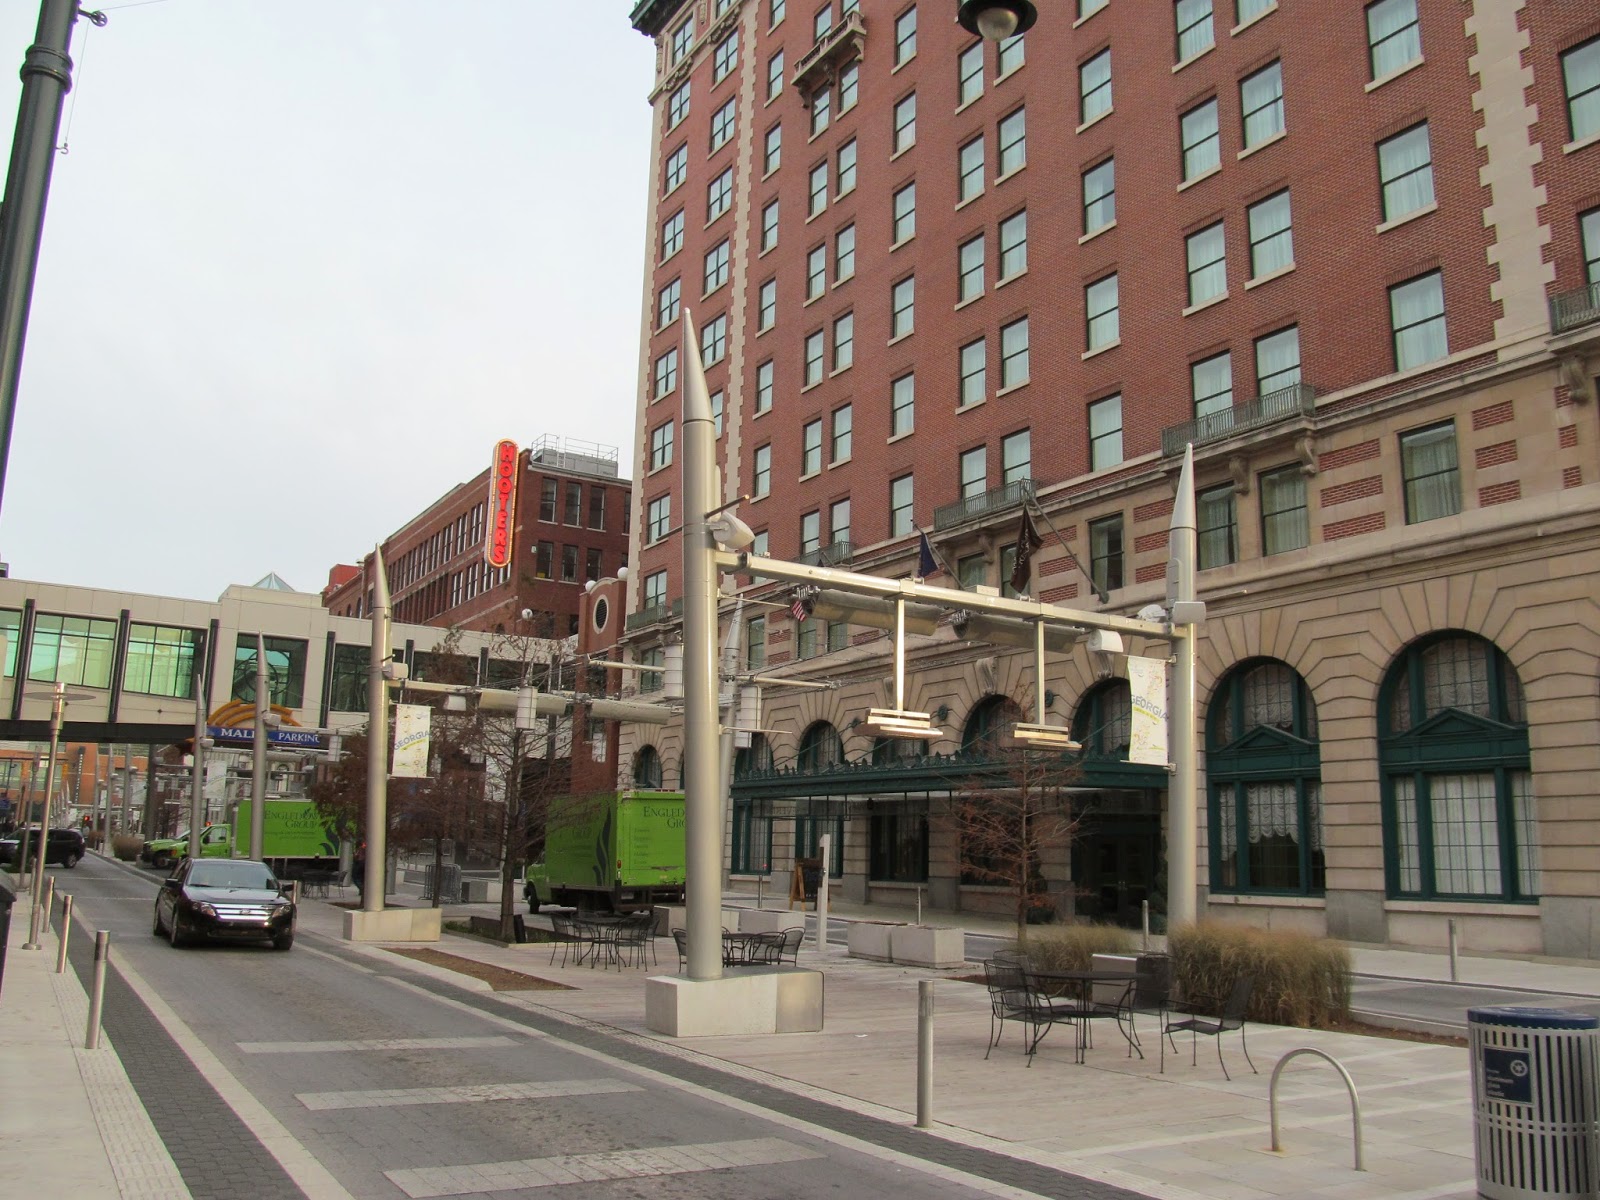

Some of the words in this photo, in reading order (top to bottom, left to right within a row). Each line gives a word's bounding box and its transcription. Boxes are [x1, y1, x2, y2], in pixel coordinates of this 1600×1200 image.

[493, 443, 516, 563] HOOTERS
[1130, 694, 1168, 722] GEORGIA
[393, 729, 431, 751] GEORGIA
[643, 806, 685, 818] ENGLED
